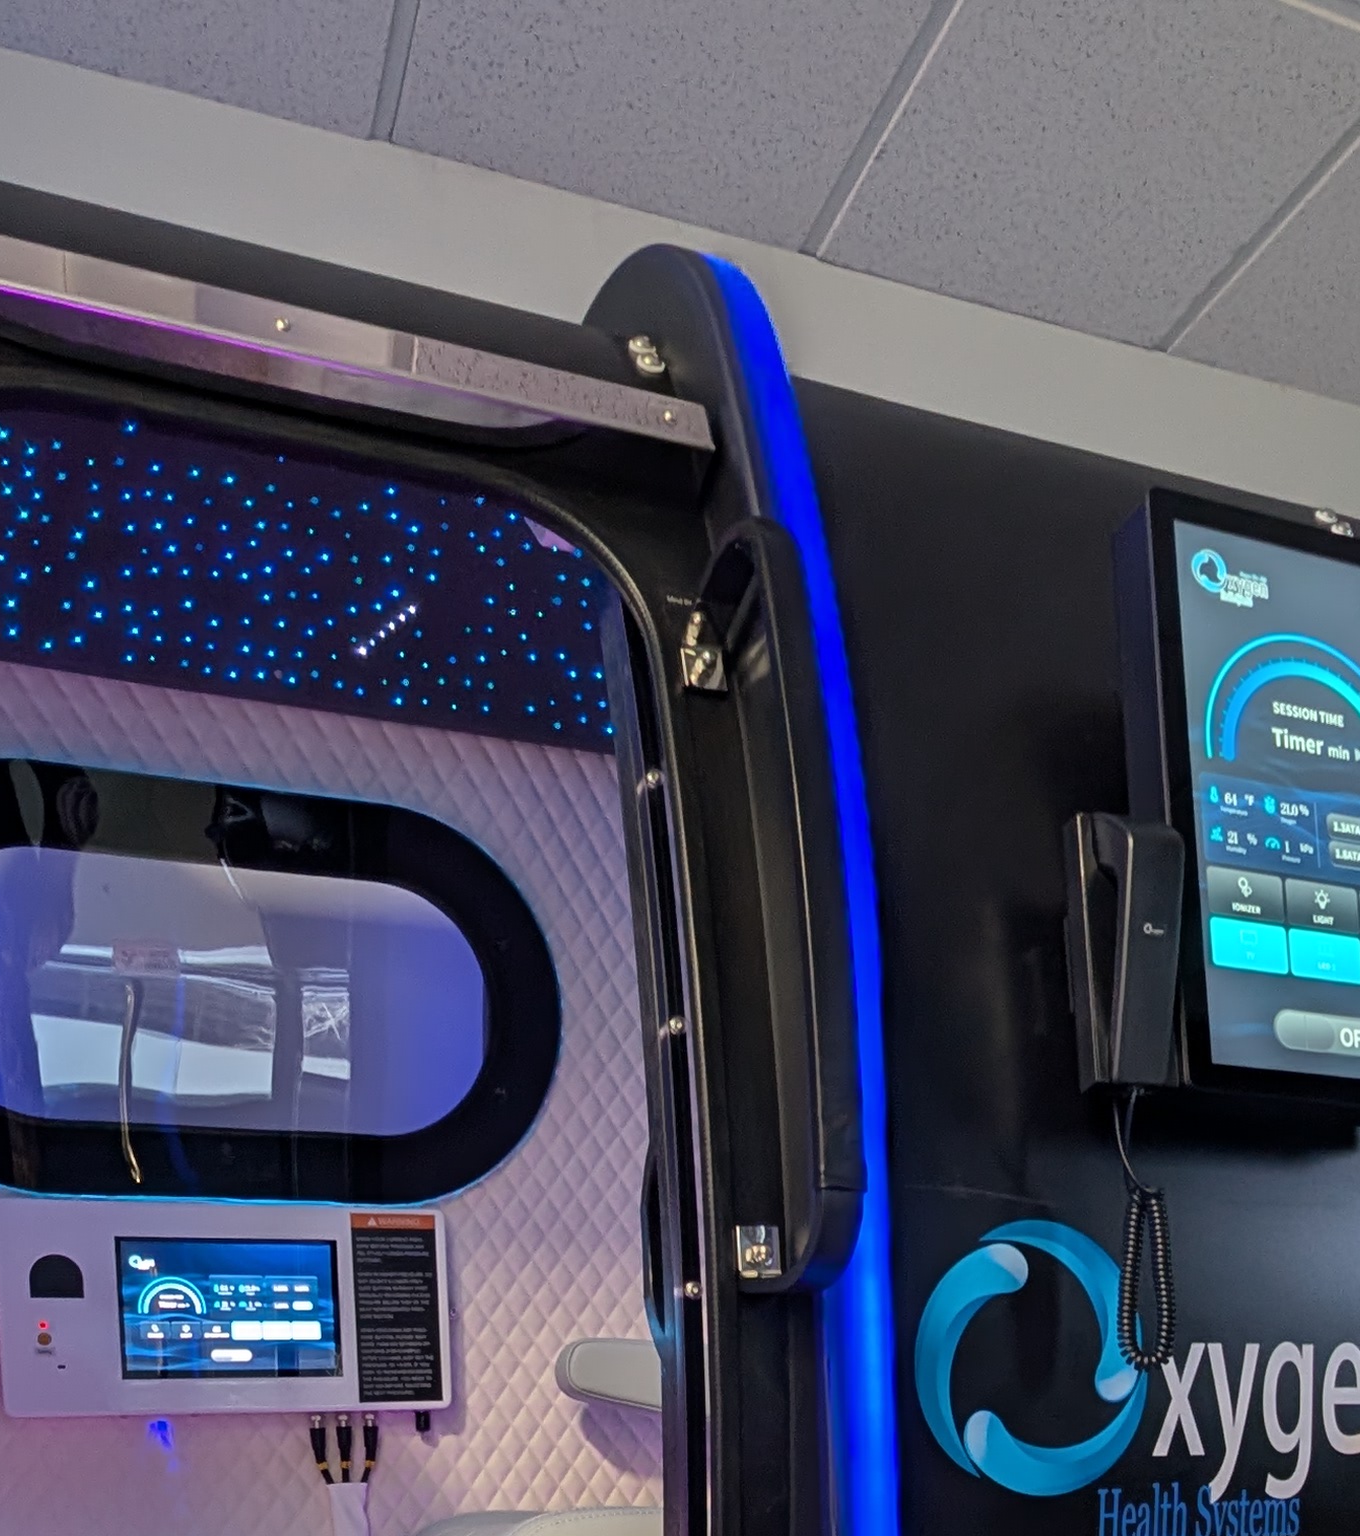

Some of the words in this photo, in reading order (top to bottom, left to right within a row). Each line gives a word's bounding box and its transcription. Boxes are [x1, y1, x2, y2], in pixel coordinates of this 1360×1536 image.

[1272, 701, 1317, 723] SESSION
[1319, 711, 1344, 728] TIME
[1271, 727, 1324, 756] Timer
[1328, 745, 1350, 761] min
[1232, 902, 1261, 915] IONIZER
[1313, 915, 1334, 926] LIGHT
